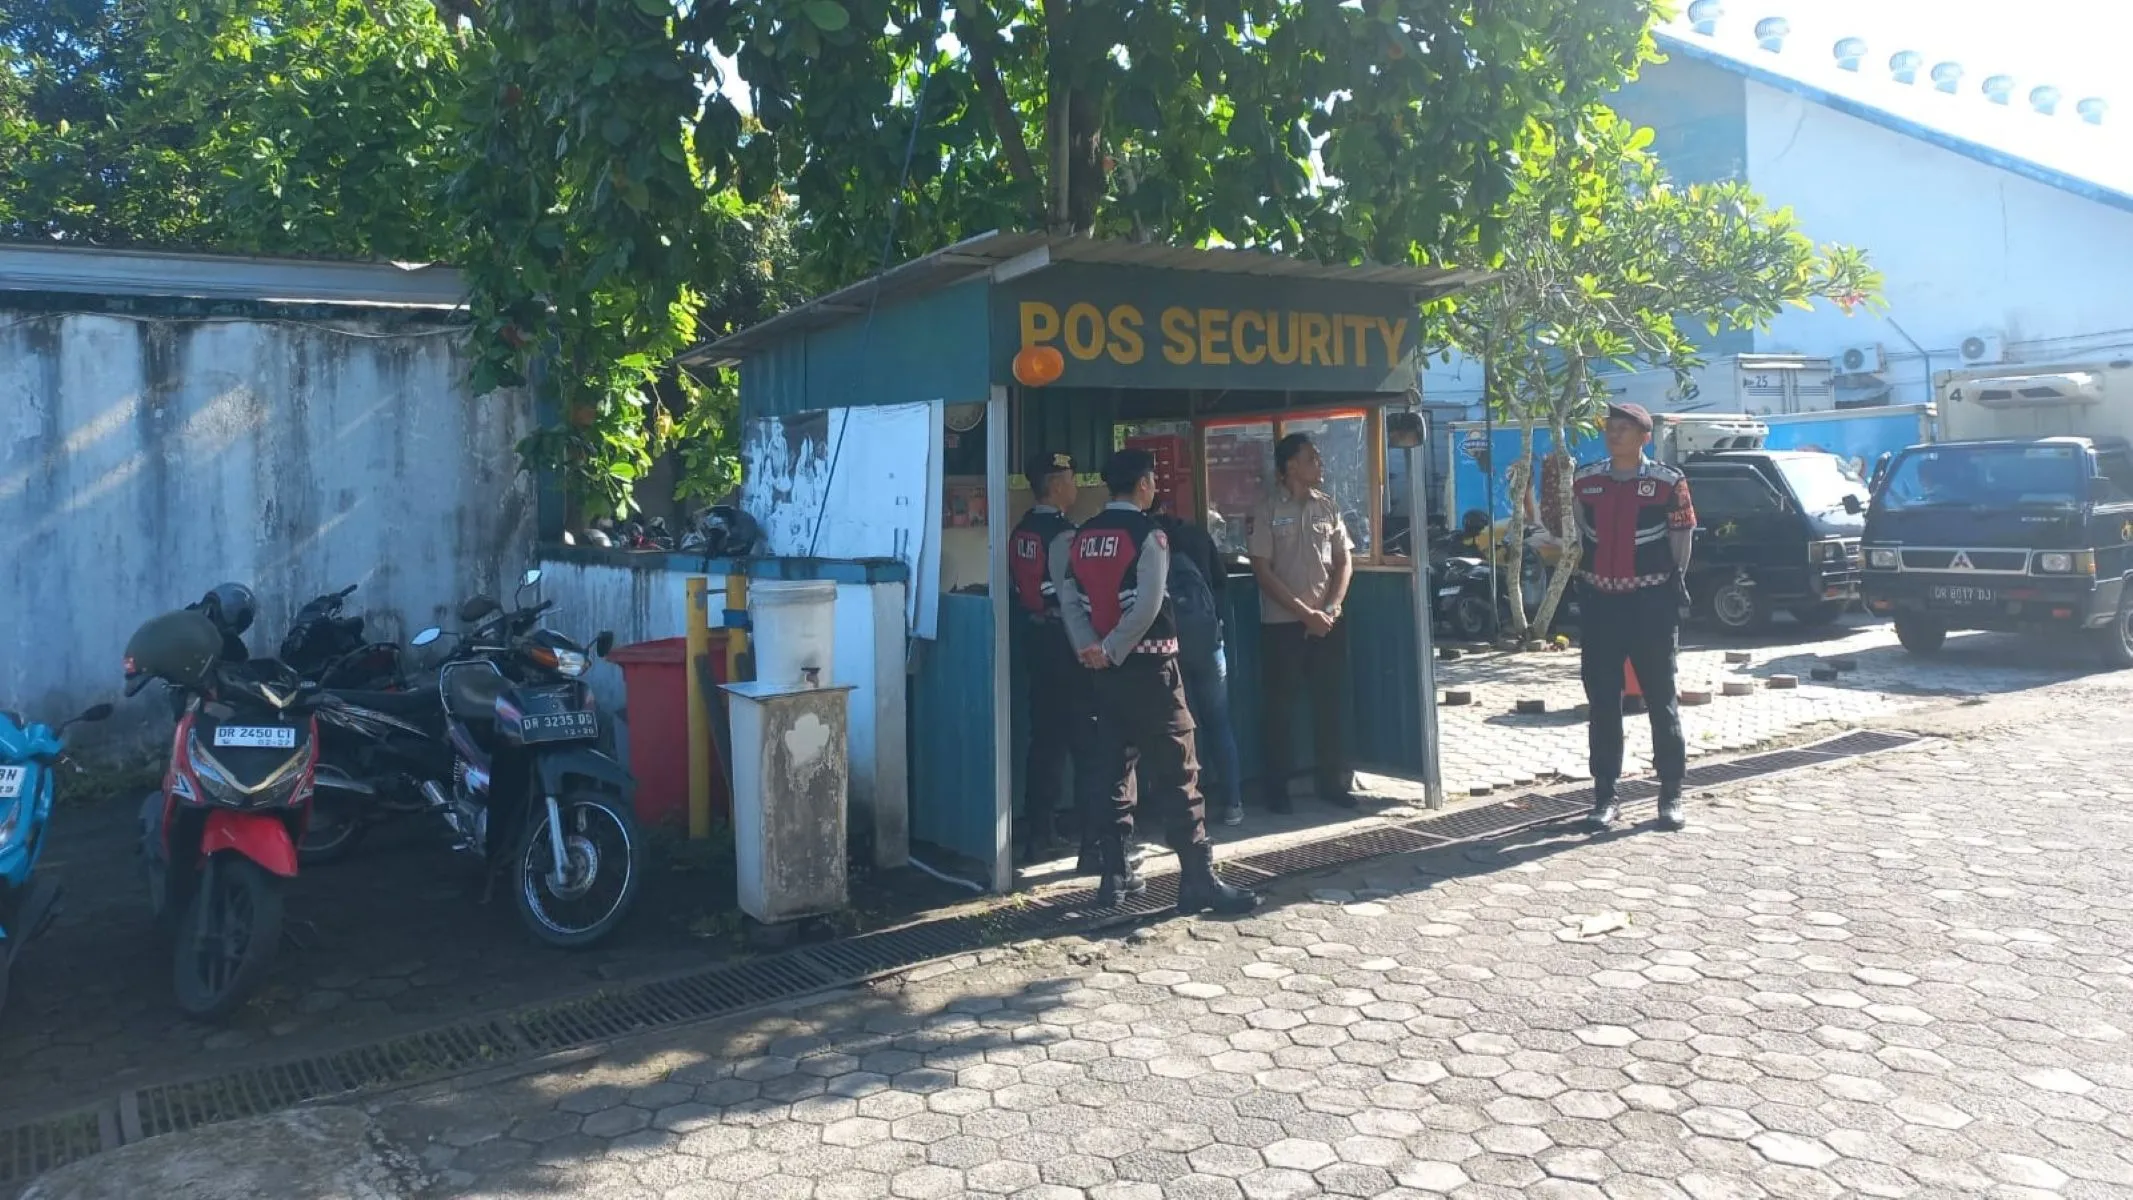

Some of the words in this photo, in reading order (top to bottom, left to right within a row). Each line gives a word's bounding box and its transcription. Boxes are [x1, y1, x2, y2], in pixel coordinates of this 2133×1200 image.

[1019, 301, 1144, 365] POS
[1161, 306, 1408, 368] SECURITY
[1950, 388, 1963, 402] 4
[1080, 536, 1119, 559] POLISI
[544, 715, 574, 727] 3235
[219, 728, 235, 738] DR
[240, 728, 273, 738] 2450
